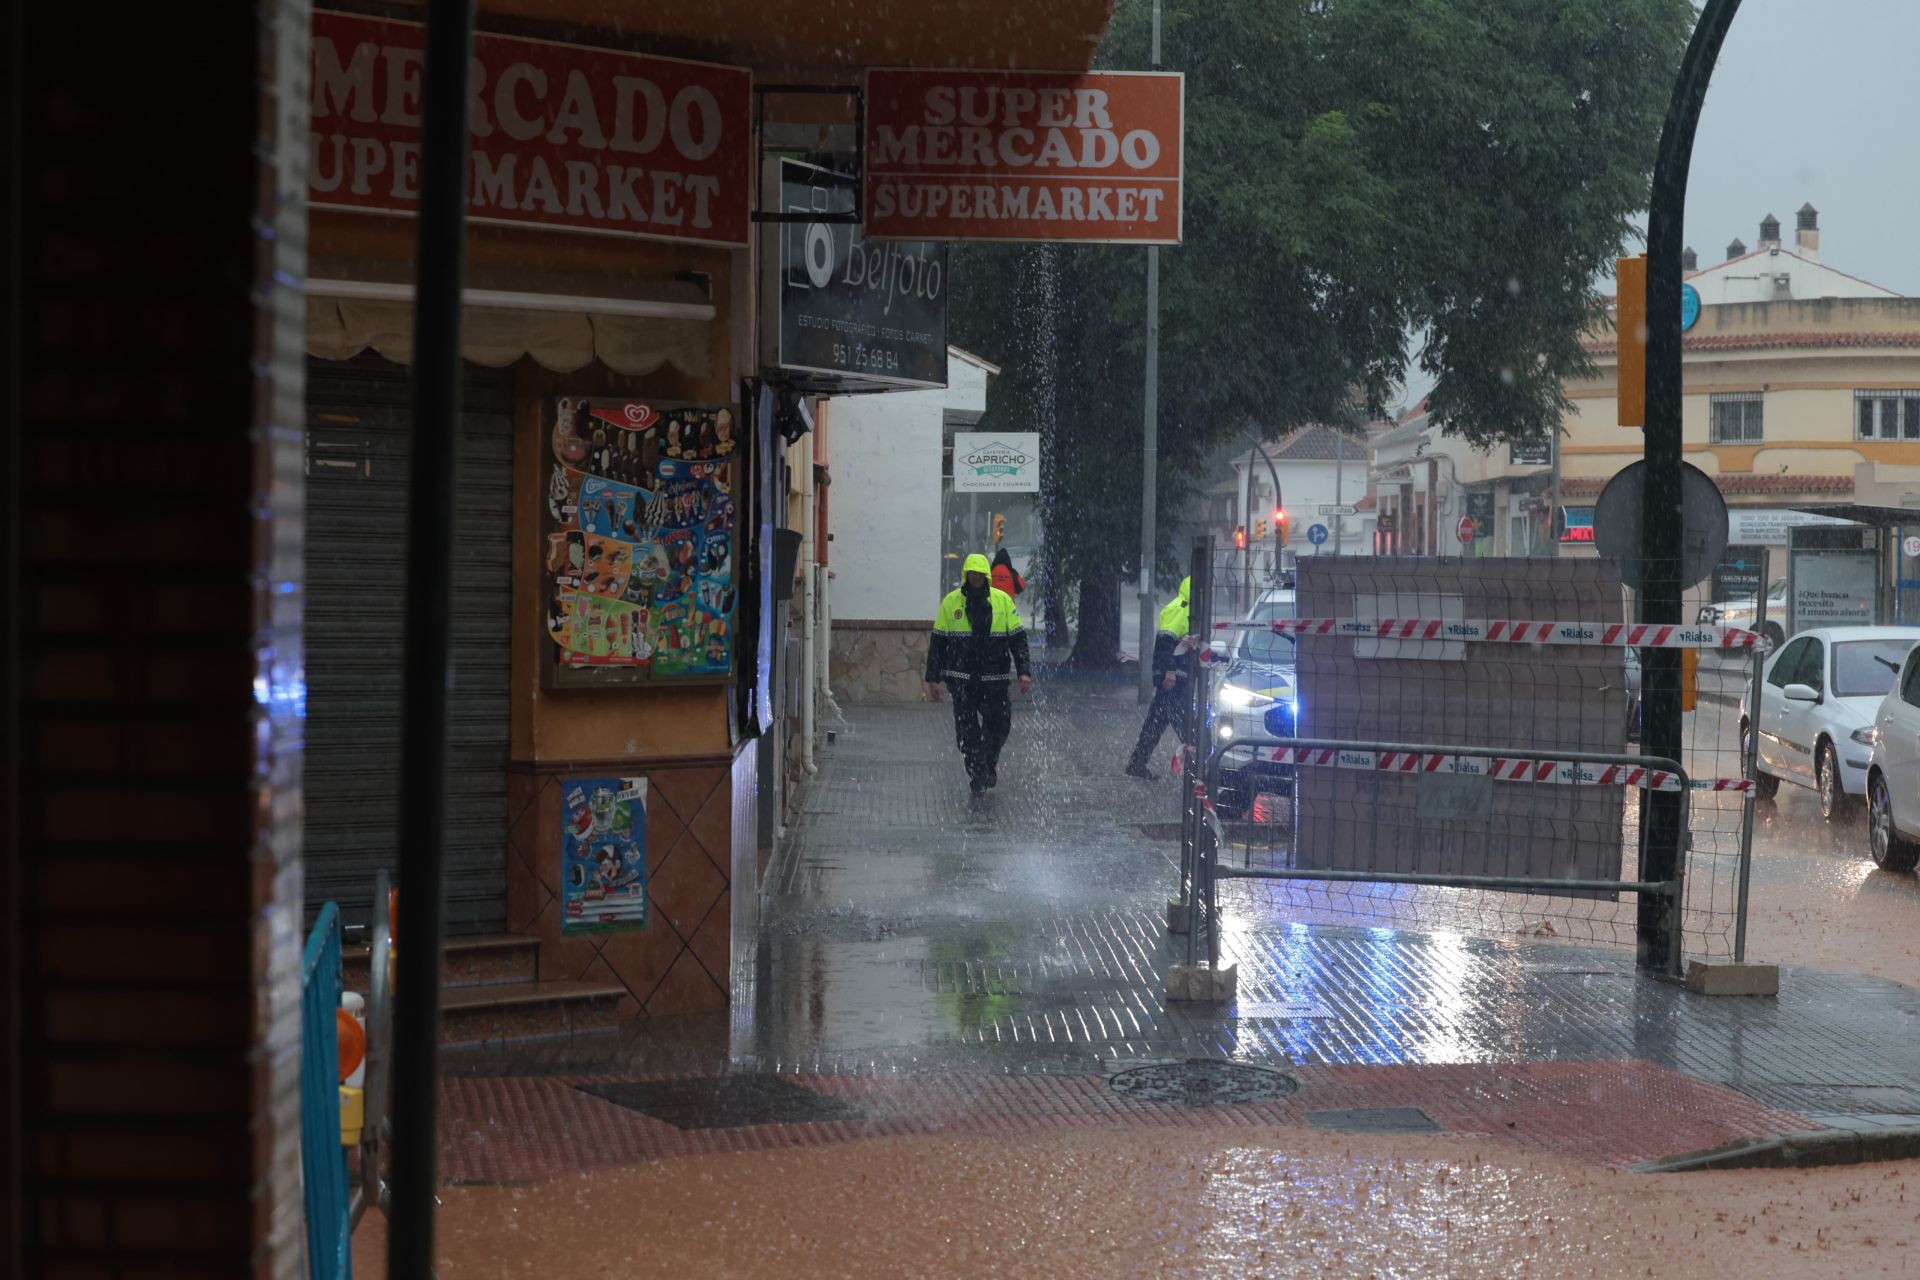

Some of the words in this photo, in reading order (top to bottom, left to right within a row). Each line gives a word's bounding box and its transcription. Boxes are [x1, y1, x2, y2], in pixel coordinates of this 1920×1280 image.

[924, 85, 1112, 129] SUPER
[873, 122, 1160, 169] MERCADO
[309, 132, 721, 229] UPEMARKET
[874, 184, 1164, 222] SUPERMARKET
[842, 223, 941, 316] Belfoto
[798, 314, 829, 330] ESTUDIO
[881, 327, 904, 341] FOTOS
[833, 343, 851, 364] 951
[856, 346, 868, 366] 25
[871, 348, 883, 368] 68
[886, 350, 899, 369] 84
[968, 455, 1026, 465] CAPRICHO
[1821, 590, 1849, 599] banco
[1808, 608, 1839, 616] mundo
[1454, 624, 1479, 635] Rialsa
[1567, 628, 1594, 640] Rialsa
[1685, 631, 1712, 642] Rialsa
[1346, 754, 1370, 766] Rialsa
[1567, 769, 1593, 781] Ralsa
